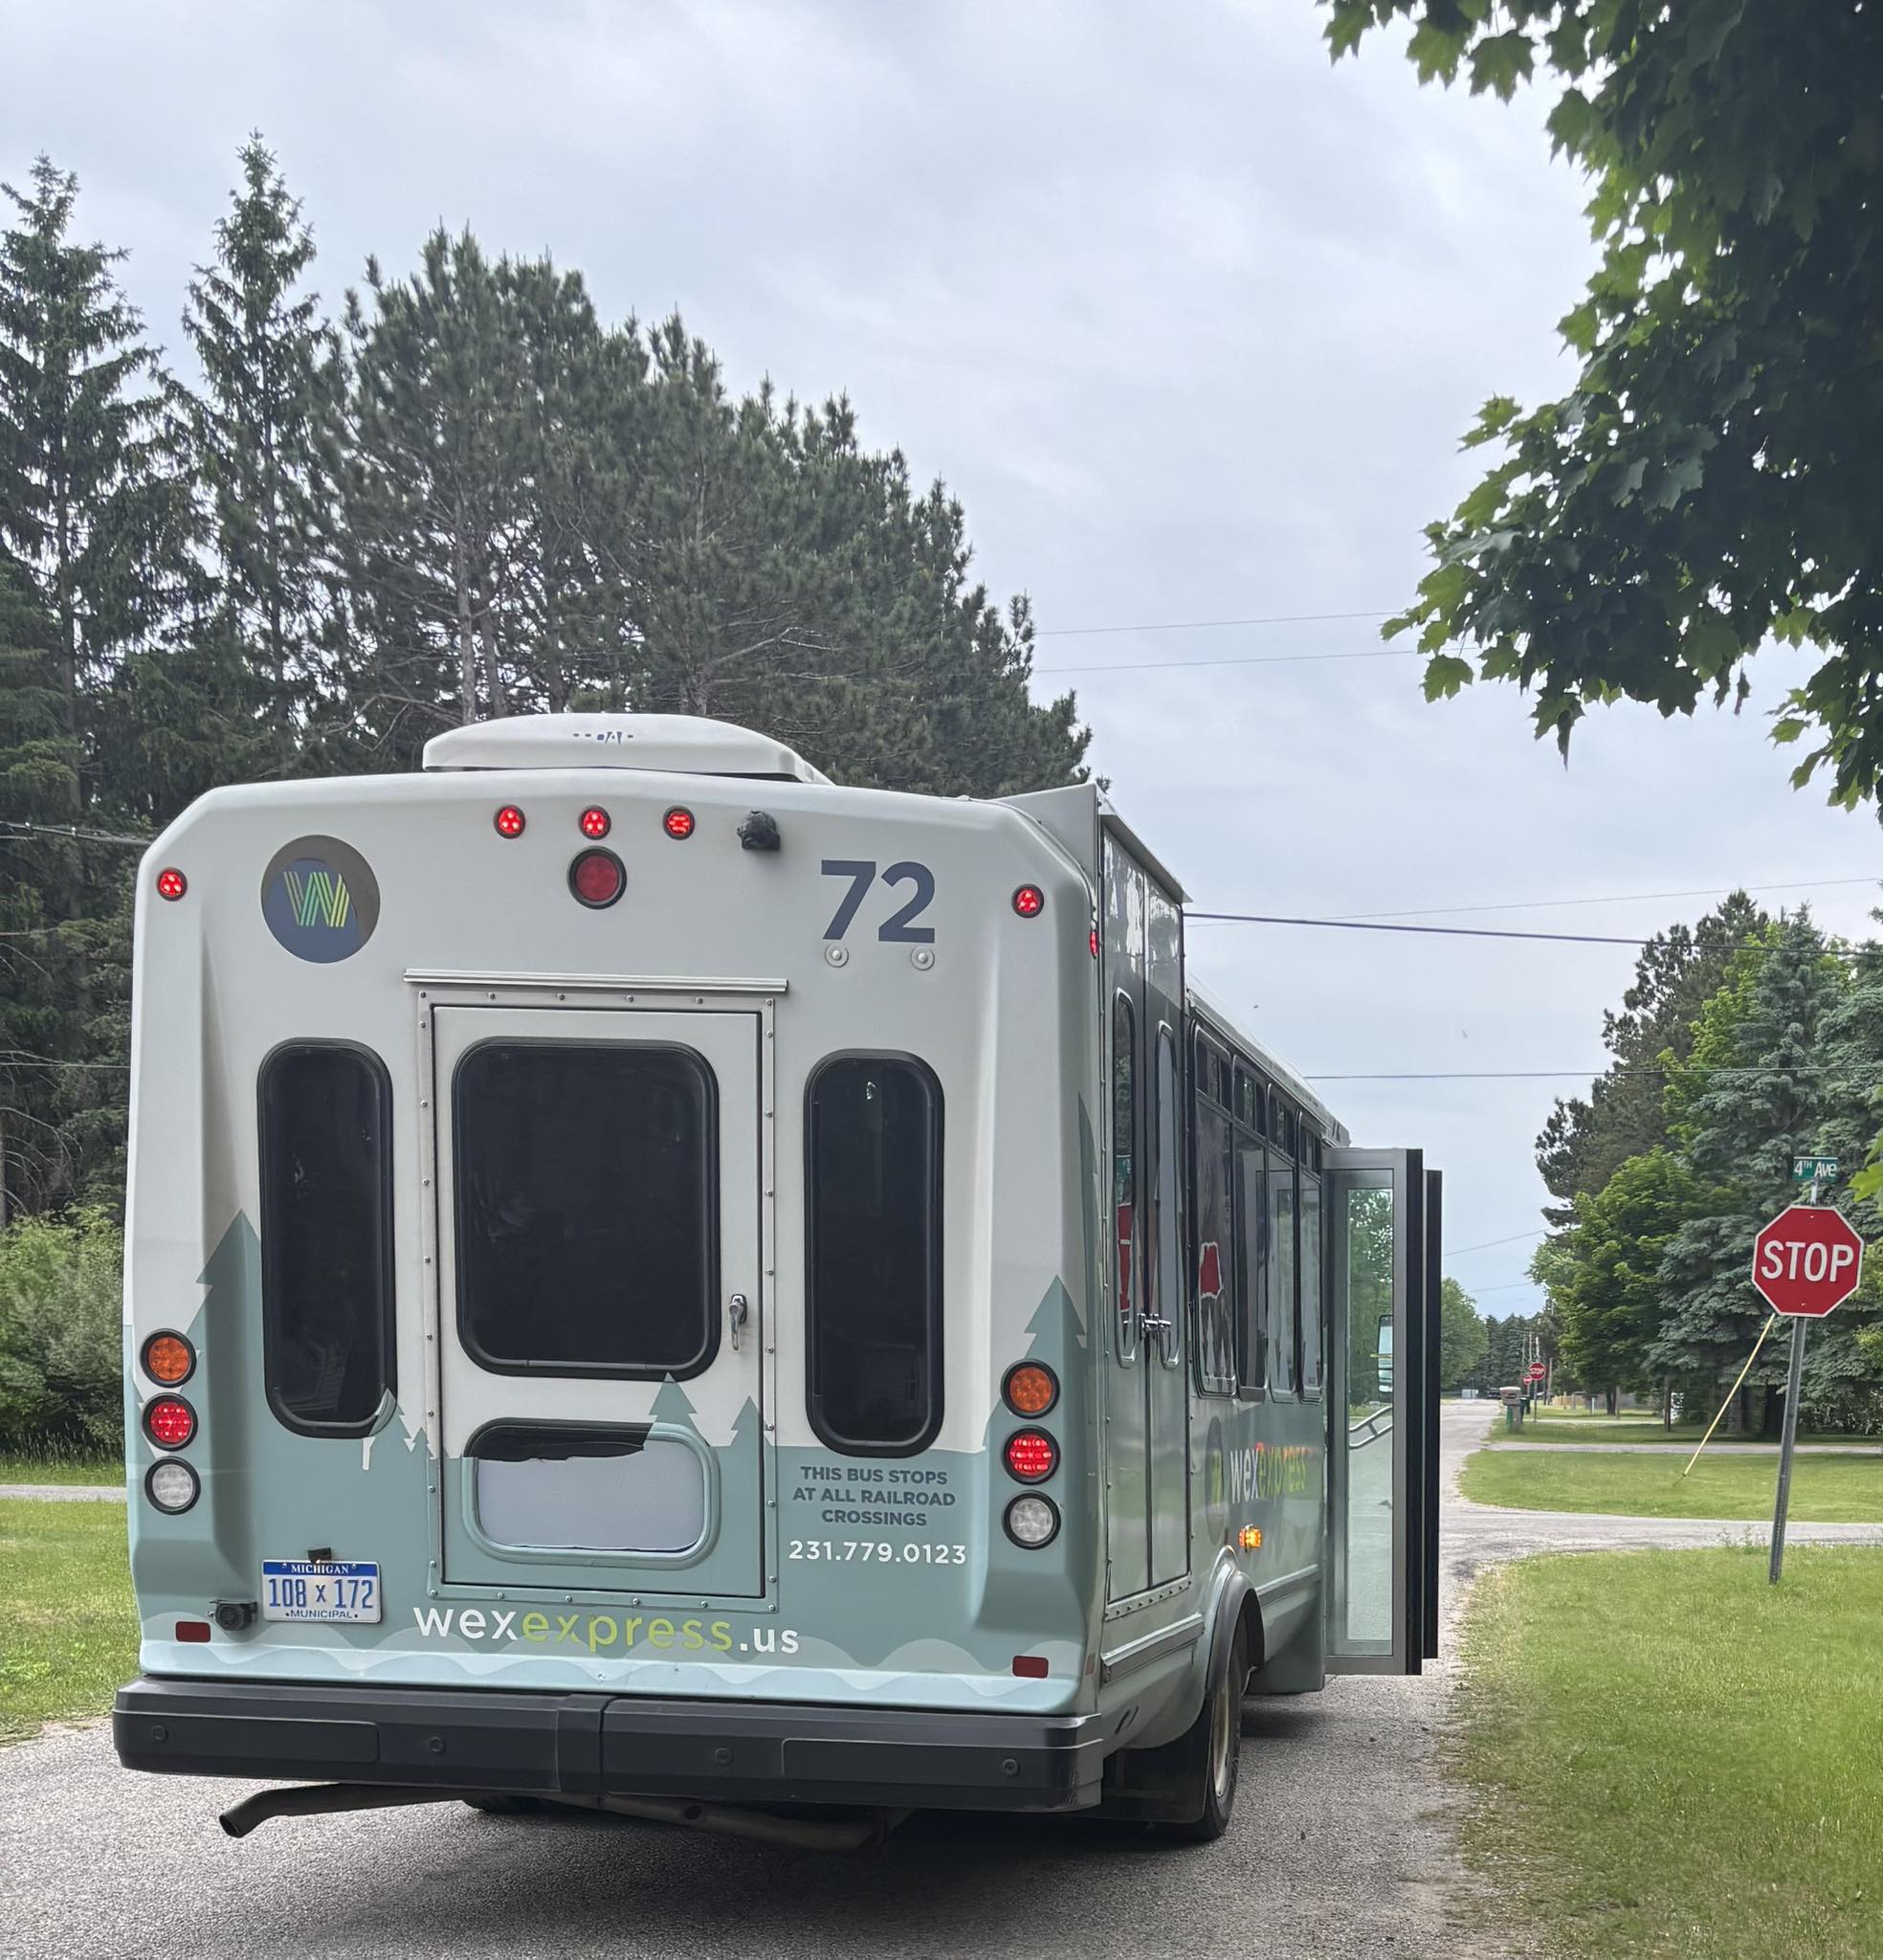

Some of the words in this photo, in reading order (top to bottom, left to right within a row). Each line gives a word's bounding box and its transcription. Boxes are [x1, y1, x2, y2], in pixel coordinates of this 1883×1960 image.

[821, 859, 935, 943] 72
[1794, 1160, 1813, 1176] 4TH
[1814, 1161, 1837, 1179] Ave
[1761, 1240, 1853, 1281] STOP
[801, 1466, 842, 1481] THIS
[847, 1468, 883, 1482] BUS
[889, 1470, 947, 1484] STOPS
[792, 1487, 816, 1501] AT
[821, 1488, 855, 1503] ALL
[861, 1490, 956, 1506] RAILROAD
[822, 1509, 926, 1526] CROSSINGS
[788, 1540, 966, 1565] 231.779.0123
[291, 1564, 349, 1574] MICHIGAN
[269, 1578, 307, 1608] 108
[334, 1579, 373, 1609] 172
[413, 1607, 800, 1654] wexexpress.us
